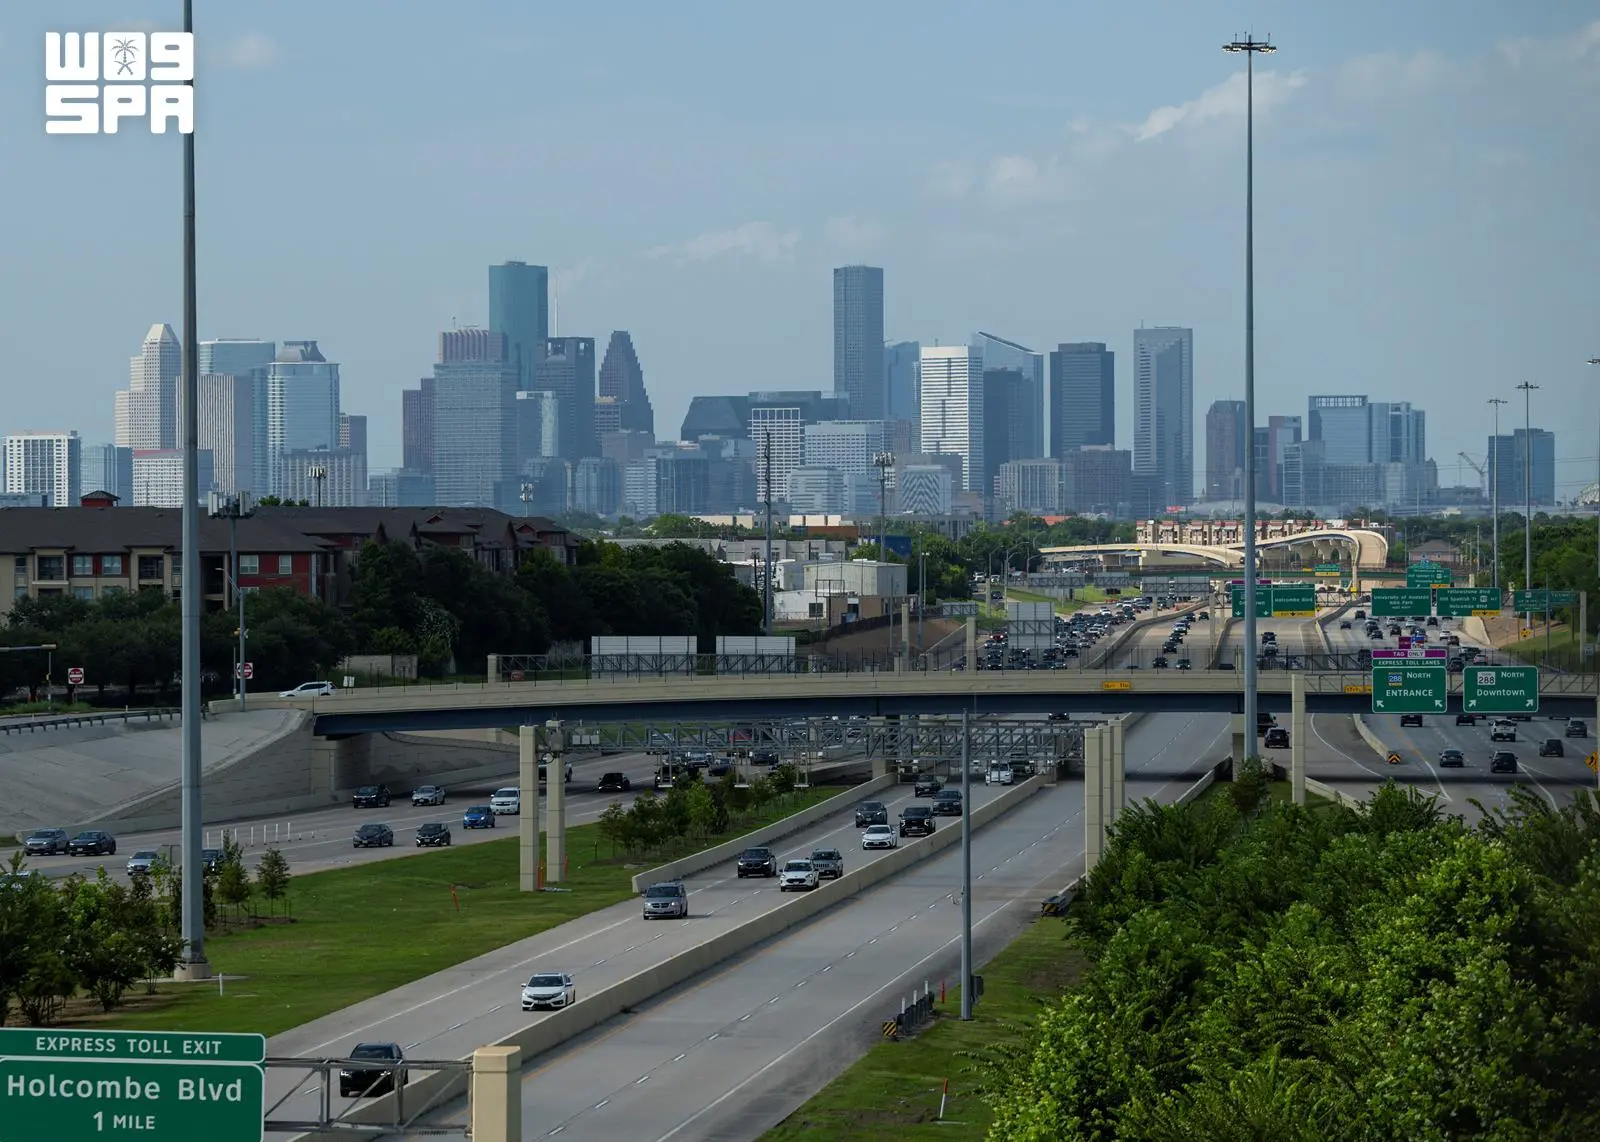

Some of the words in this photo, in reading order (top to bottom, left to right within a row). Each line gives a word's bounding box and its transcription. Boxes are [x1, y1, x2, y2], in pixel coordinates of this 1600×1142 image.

[1478, 676, 1495, 684] 288
[1385, 689, 1433, 697] ENTRANCE
[1476, 688, 1525, 697] Downtown
[36, 1037, 116, 1052] EXPRESS
[127, 1039, 172, 1054] TOLL
[183, 1040, 222, 1055] EXIT
[7, 1074, 160, 1100] Holcombe
[178, 1078, 242, 1102] Blvd
[93, 1111, 103, 1131] 1
[113, 1115, 155, 1130] MILE
